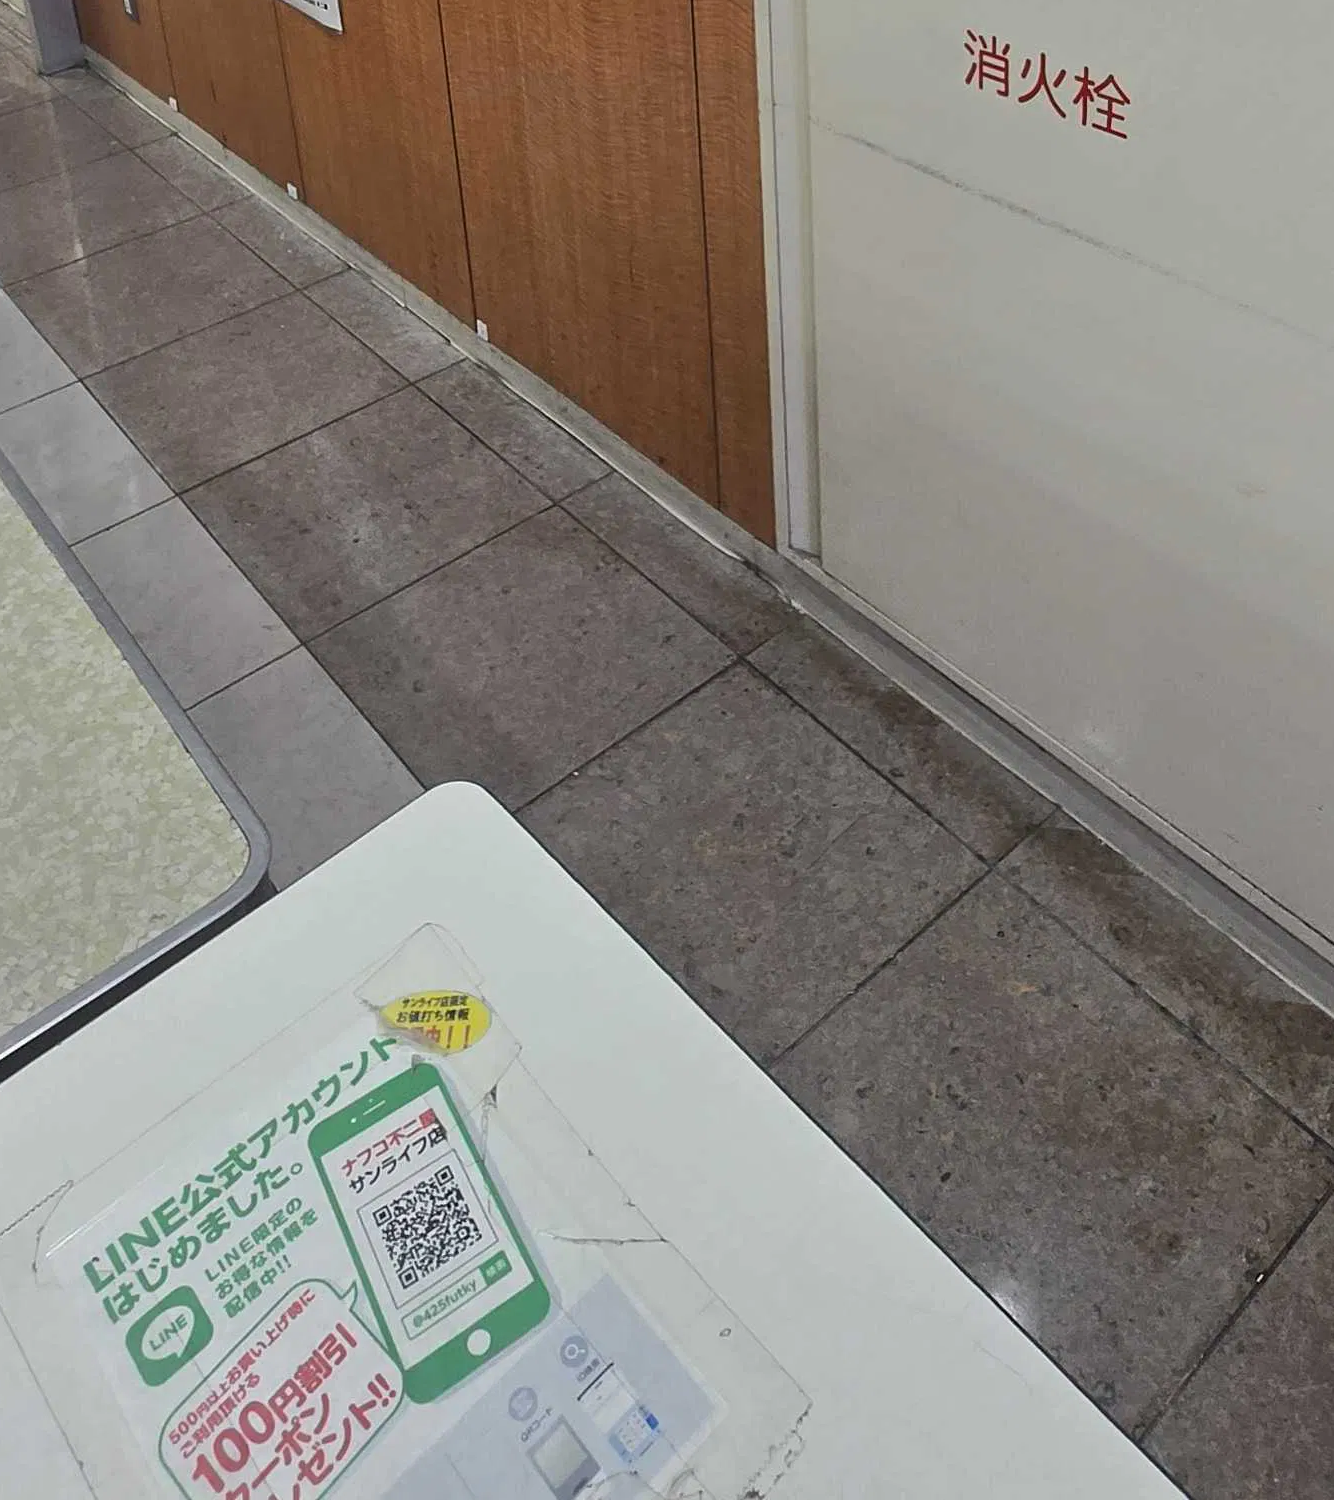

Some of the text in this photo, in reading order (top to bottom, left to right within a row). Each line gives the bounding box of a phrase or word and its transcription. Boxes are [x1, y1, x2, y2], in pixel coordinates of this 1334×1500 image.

[963, 29, 1133, 141] 消火栓
[395, 1007, 471, 1023] お値打ち情報
[75, 1025, 409, 1294] LINE公式アカウント
[337, 1097, 440, 1187] ナフコ不二屋
[345, 1114, 449, 1205] サンライフ店
[94, 1147, 311, 1326] はじめました。
[200, 1193, 308, 1284] LINE限定の
[209, 1205, 323, 1302] お得な情報を
[146, 1311, 191, 1353] LINE
[168, 1284, 319, 1445] 500円以上お買い上げ時に
[181, 1372, 261, 1460] ご利用頂ける
[191, 1320, 359, 1494] 100円割引
